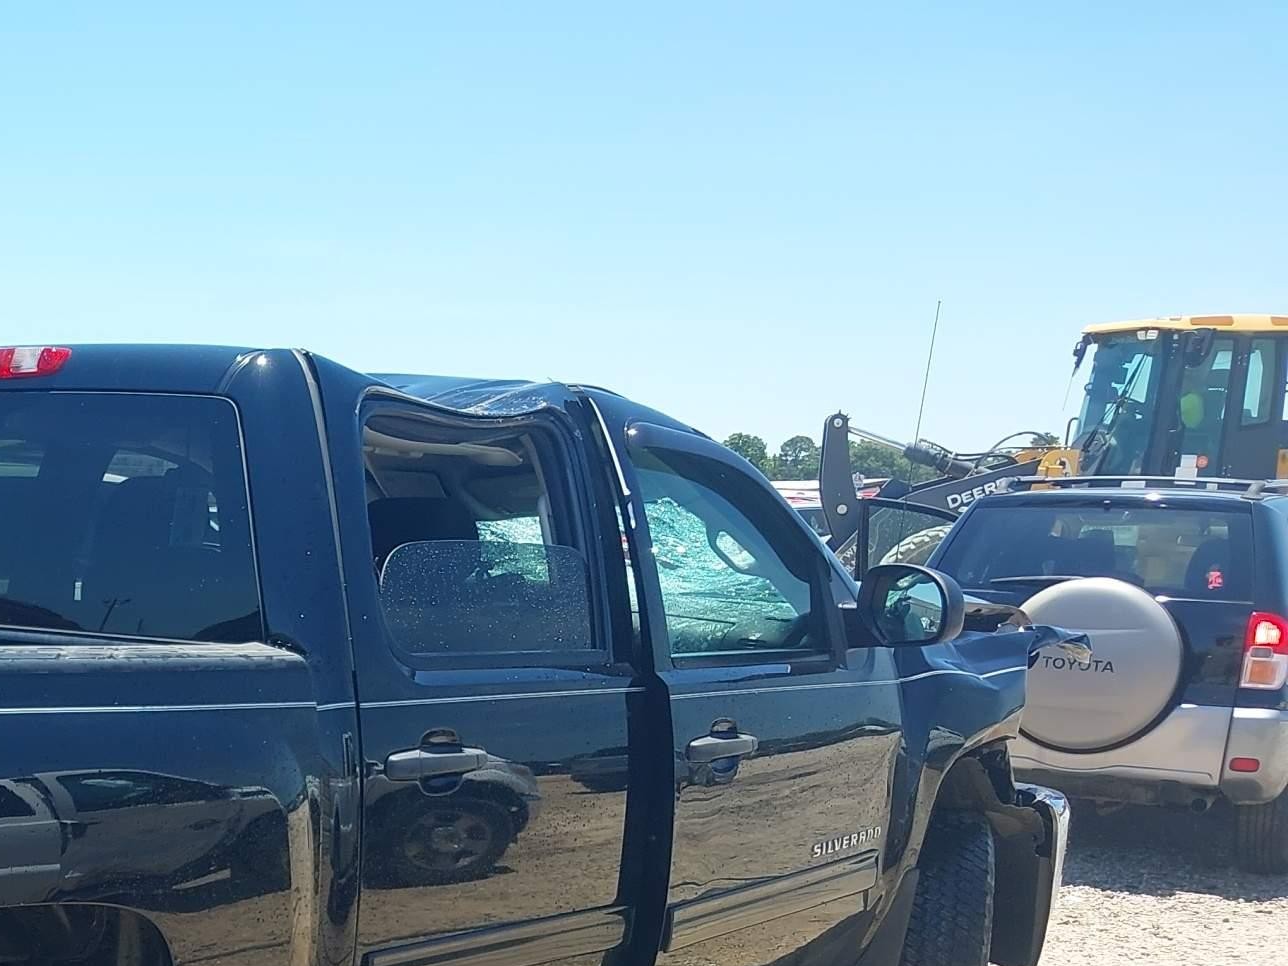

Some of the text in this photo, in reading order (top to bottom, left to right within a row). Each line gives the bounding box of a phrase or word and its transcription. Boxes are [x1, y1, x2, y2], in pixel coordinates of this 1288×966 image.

[946, 479, 1001, 509] DEER
[1042, 656, 1114, 673] TOYOTA
[812, 826, 881, 858] SILVERADO
